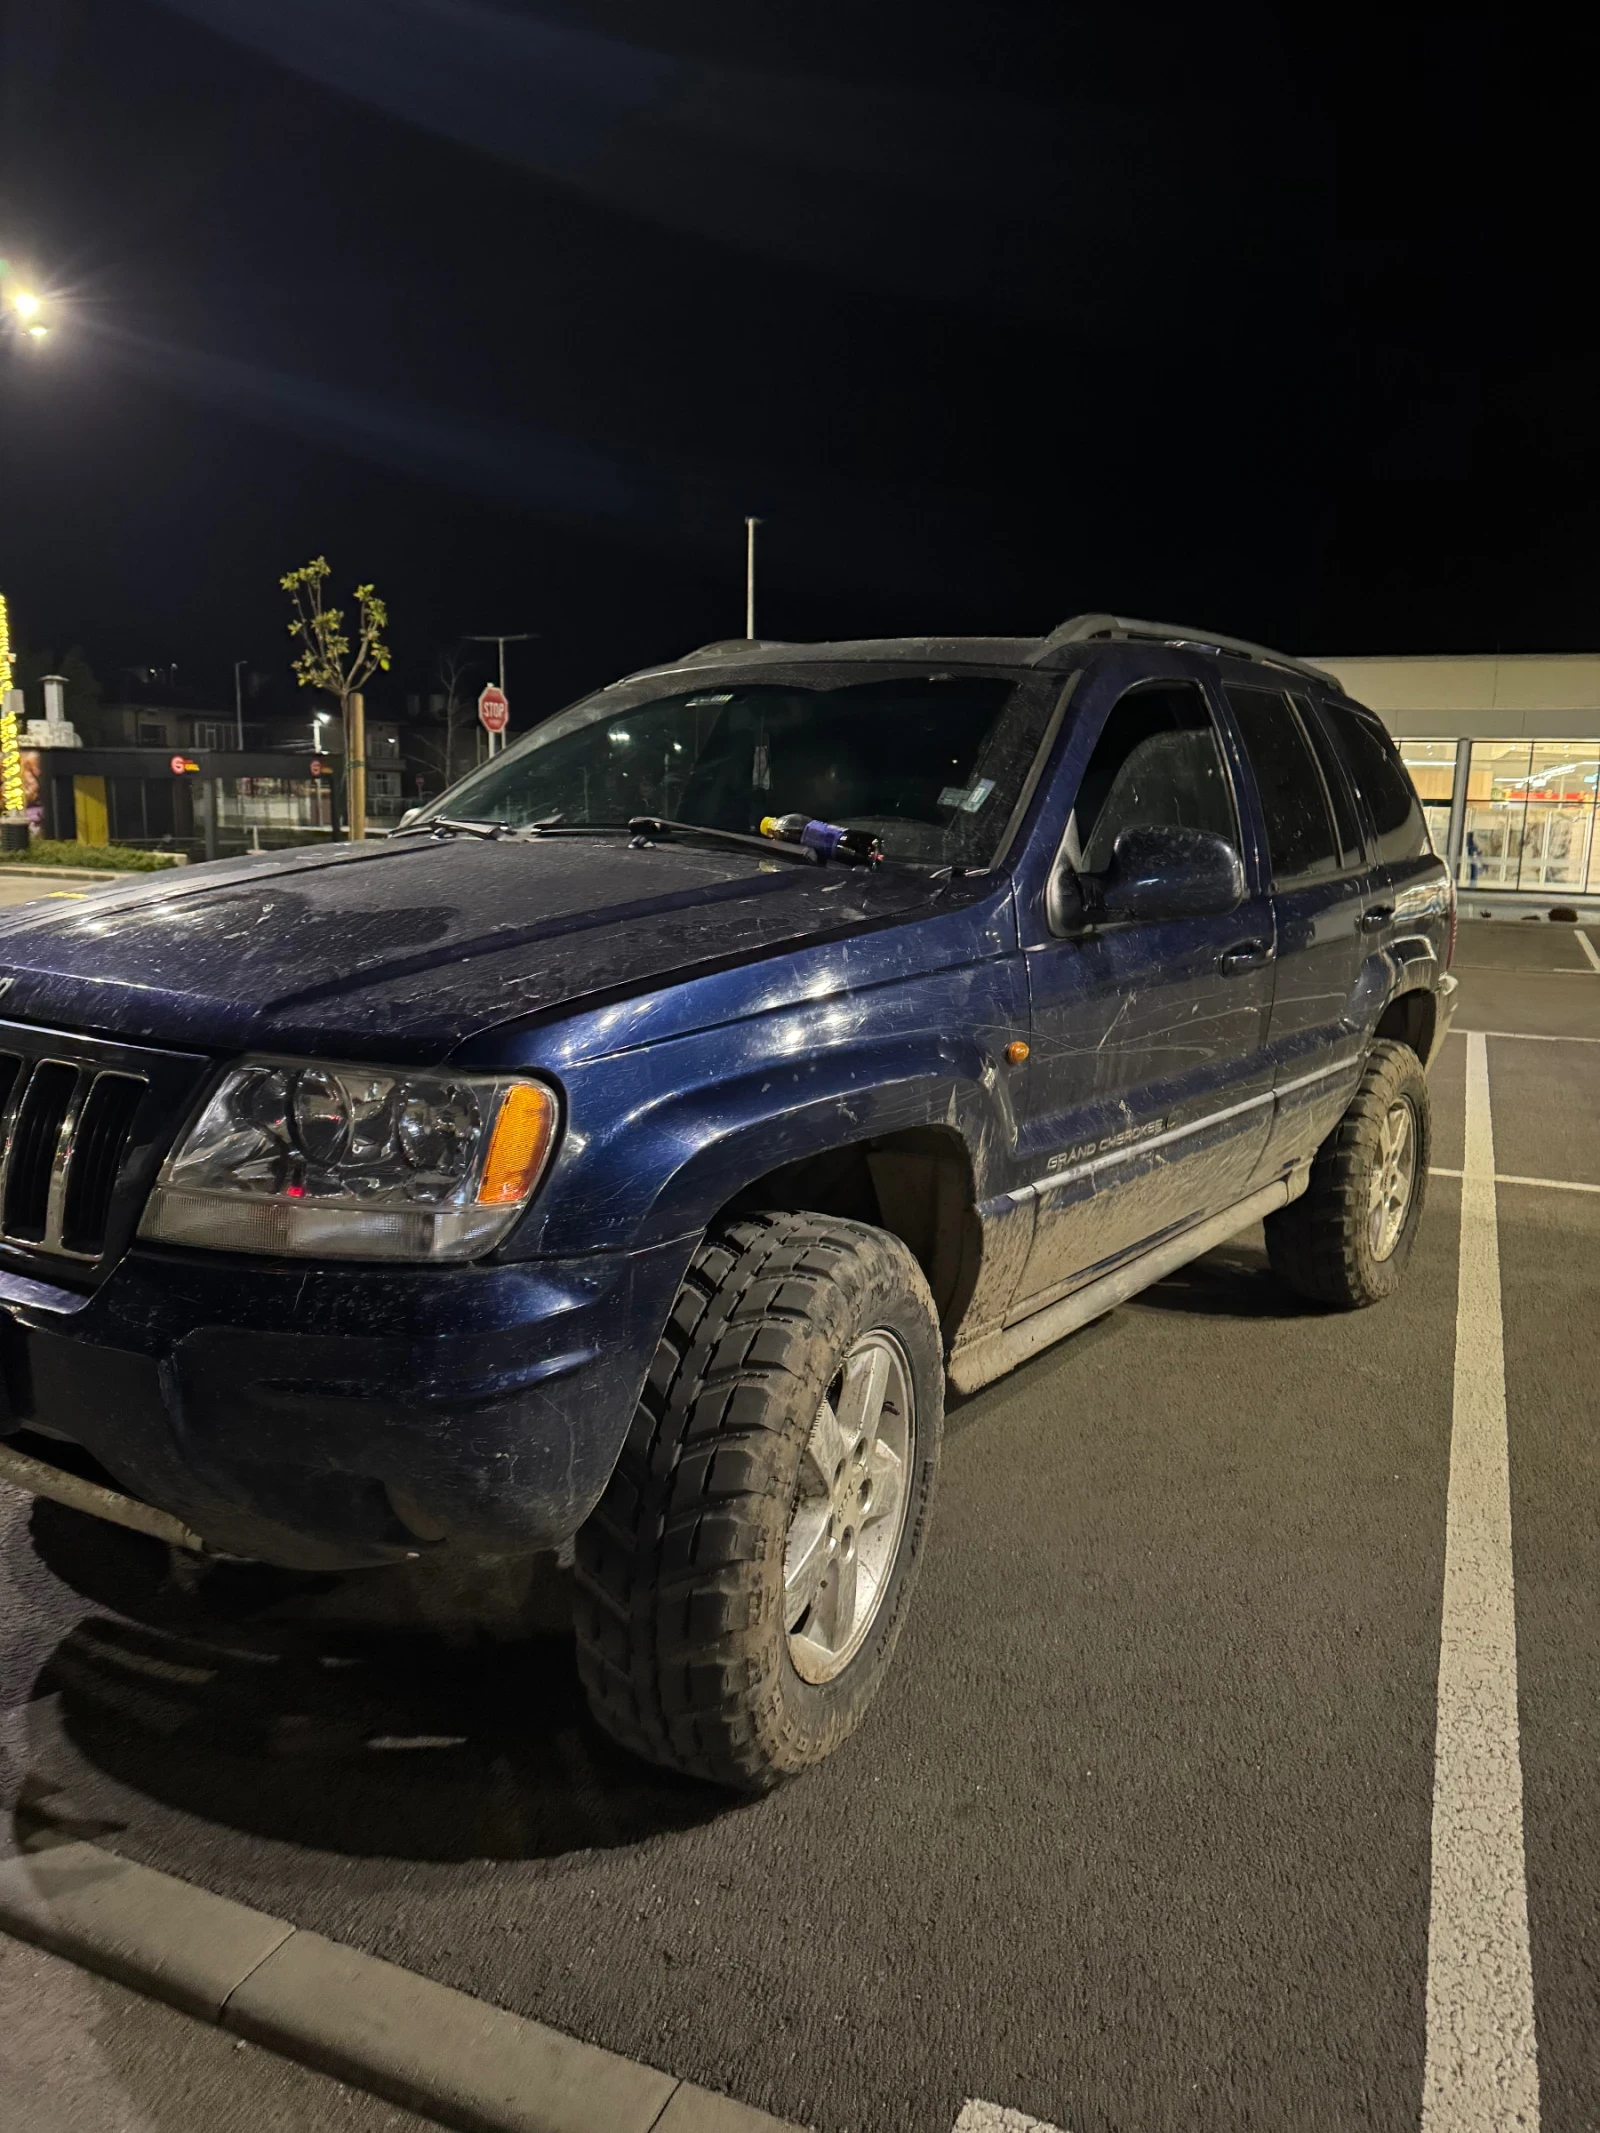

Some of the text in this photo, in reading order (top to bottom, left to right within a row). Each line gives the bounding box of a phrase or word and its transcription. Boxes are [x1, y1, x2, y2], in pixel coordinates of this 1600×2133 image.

[484, 701, 505, 718] STOP
[1047, 1118, 1164, 1169] GRAND CHEROKEE
